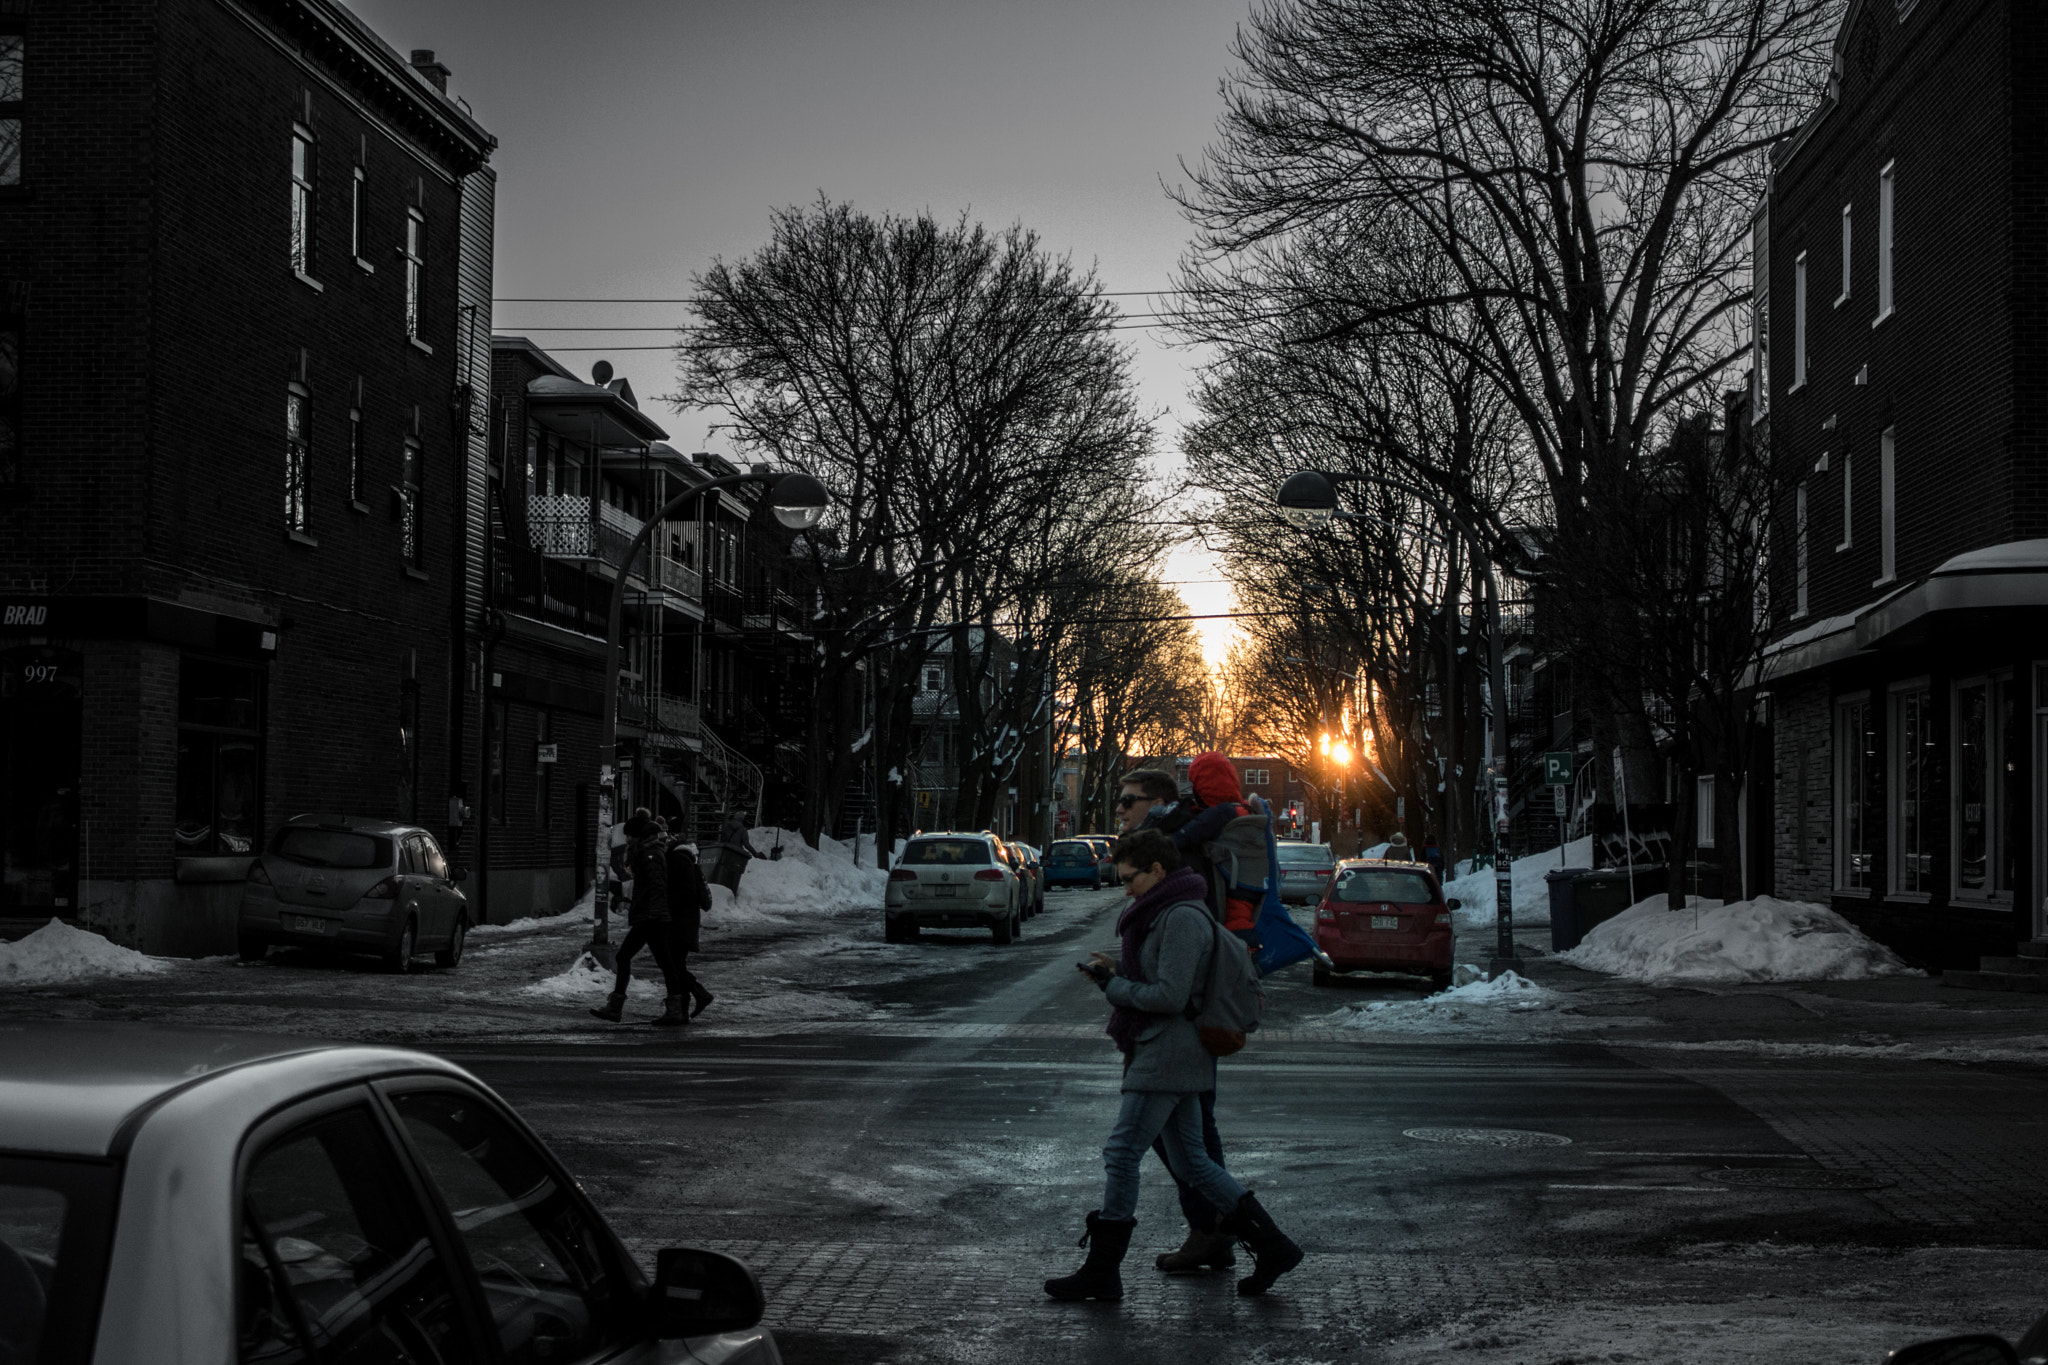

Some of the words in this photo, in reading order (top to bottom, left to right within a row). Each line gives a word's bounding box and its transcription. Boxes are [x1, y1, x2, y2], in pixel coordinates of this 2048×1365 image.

[3, 605, 48, 625] BRAD
[25, 665, 58, 683] 997
[1549, 759, 1560, 778] P
